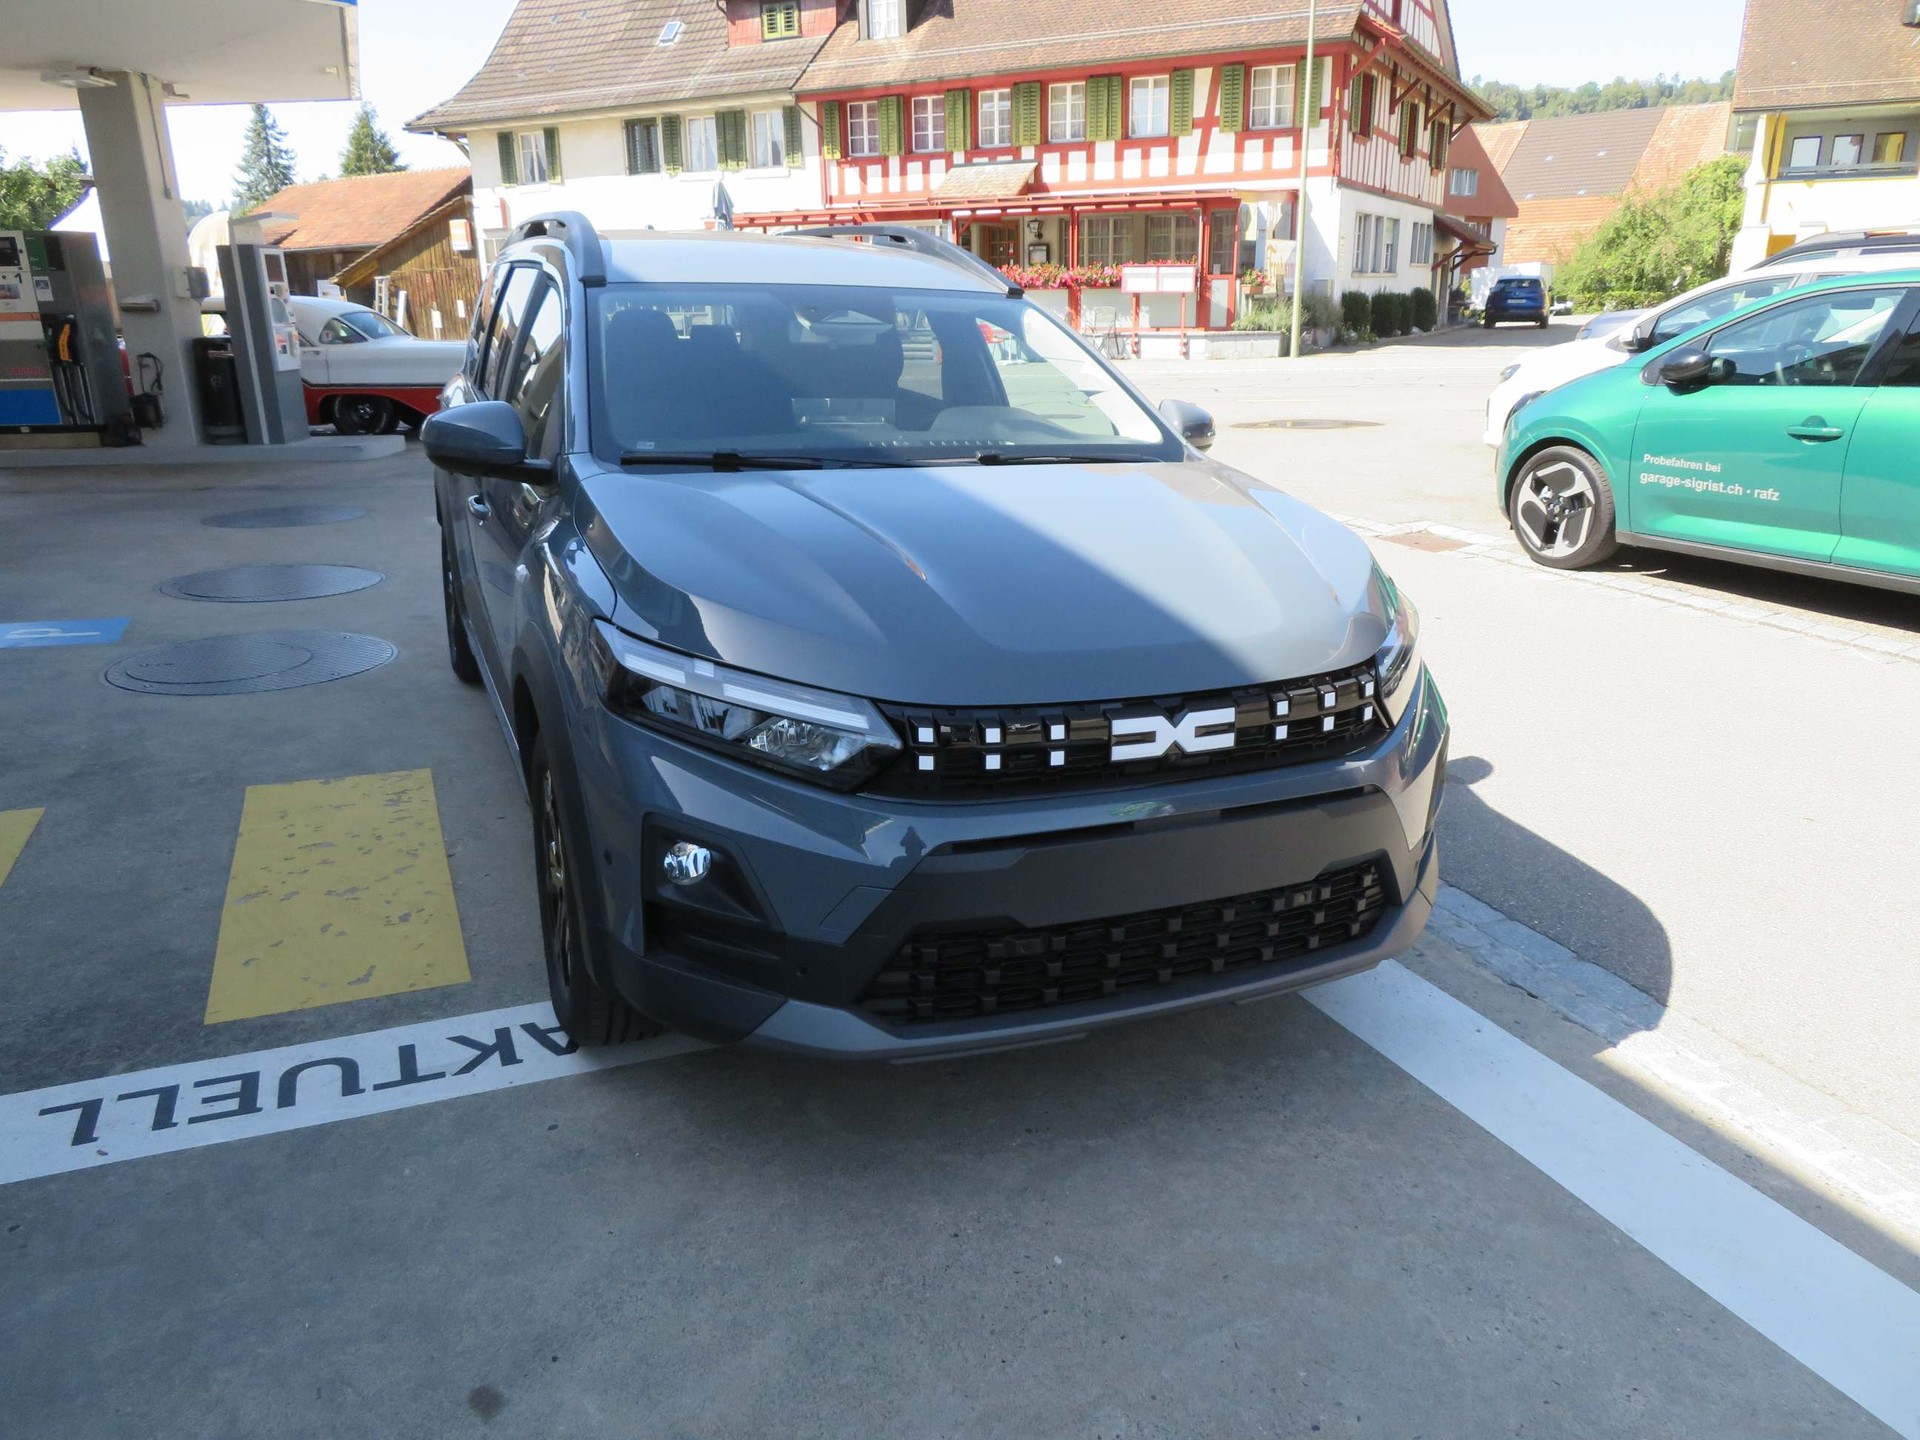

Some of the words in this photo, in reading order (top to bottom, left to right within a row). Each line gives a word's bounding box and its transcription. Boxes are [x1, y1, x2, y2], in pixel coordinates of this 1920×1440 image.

[1643, 454, 1702, 470] Probefahren
[1705, 462, 1721, 472] bei
[1640, 472, 1743, 496] garage-sigrist.ch
[1754, 488, 1780, 501] rafz
[38, 1021, 579, 1147] AKTUELL
